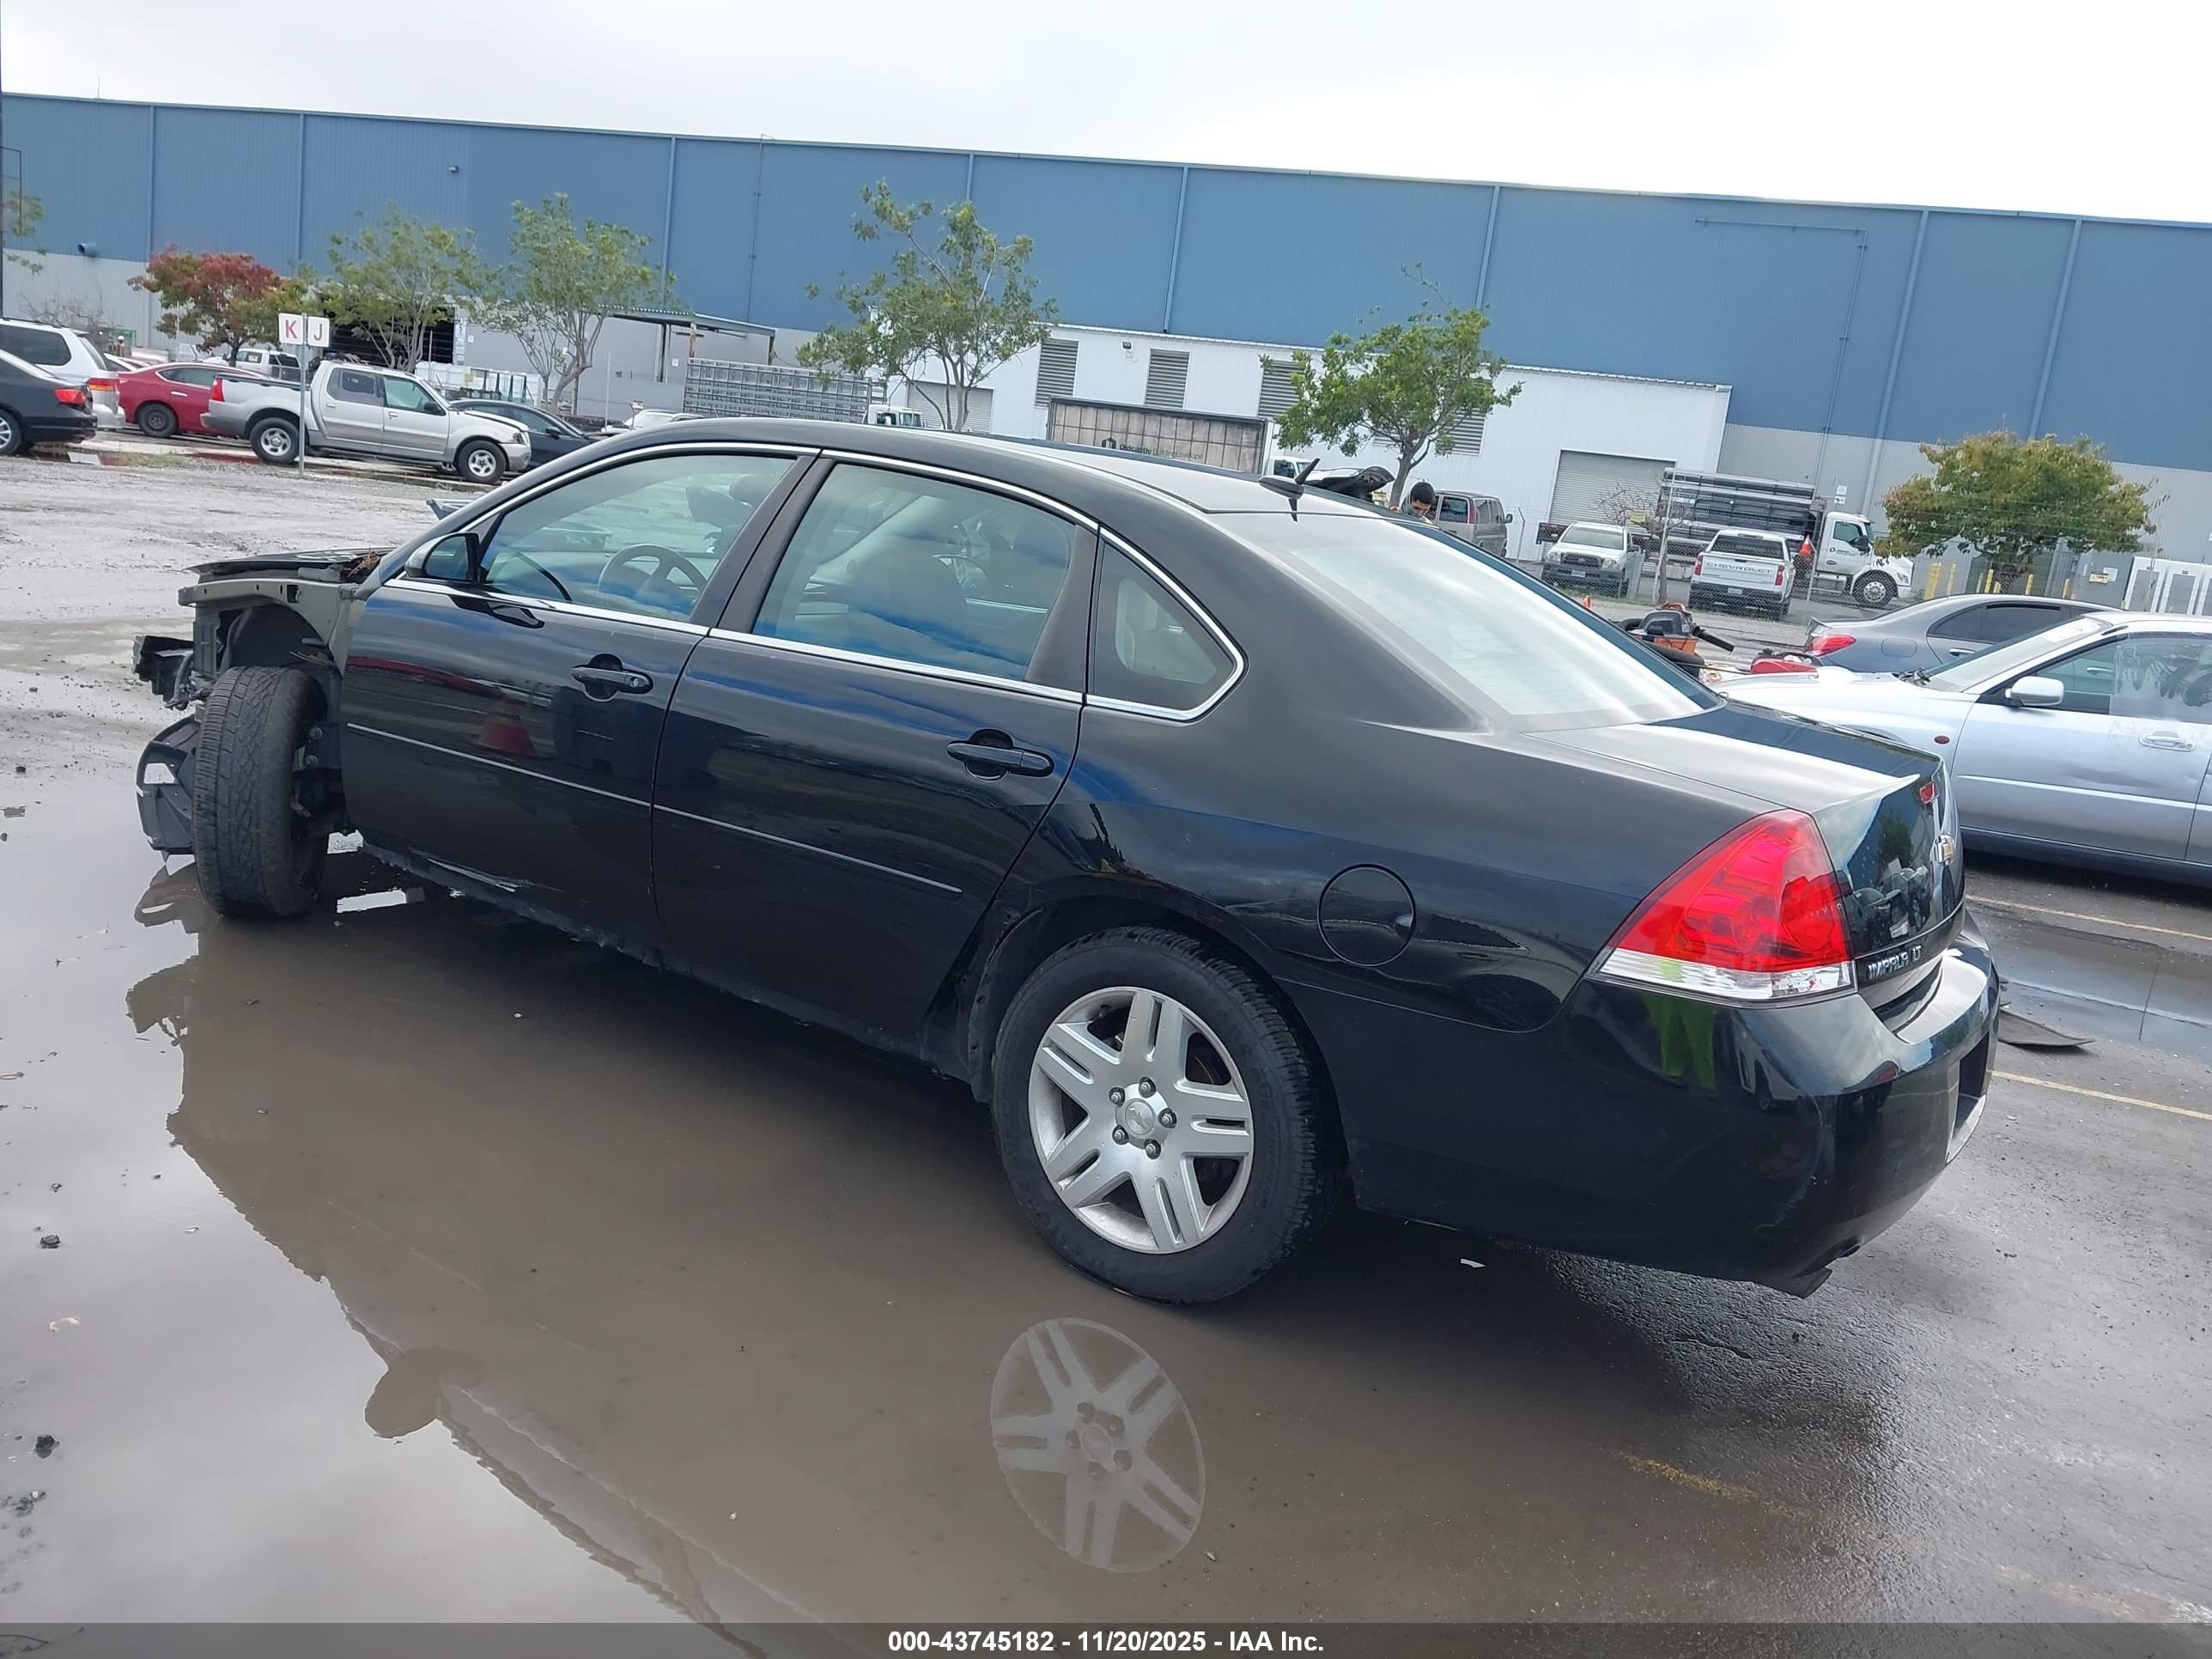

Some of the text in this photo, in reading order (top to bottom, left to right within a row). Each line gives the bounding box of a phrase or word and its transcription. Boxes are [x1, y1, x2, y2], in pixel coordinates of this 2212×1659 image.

[285, 319, 298, 339] K
[313, 323, 323, 341] J
[1706, 562, 1773, 574] CHEVROLET
[1868, 945, 1923, 979] IMPALA LT
